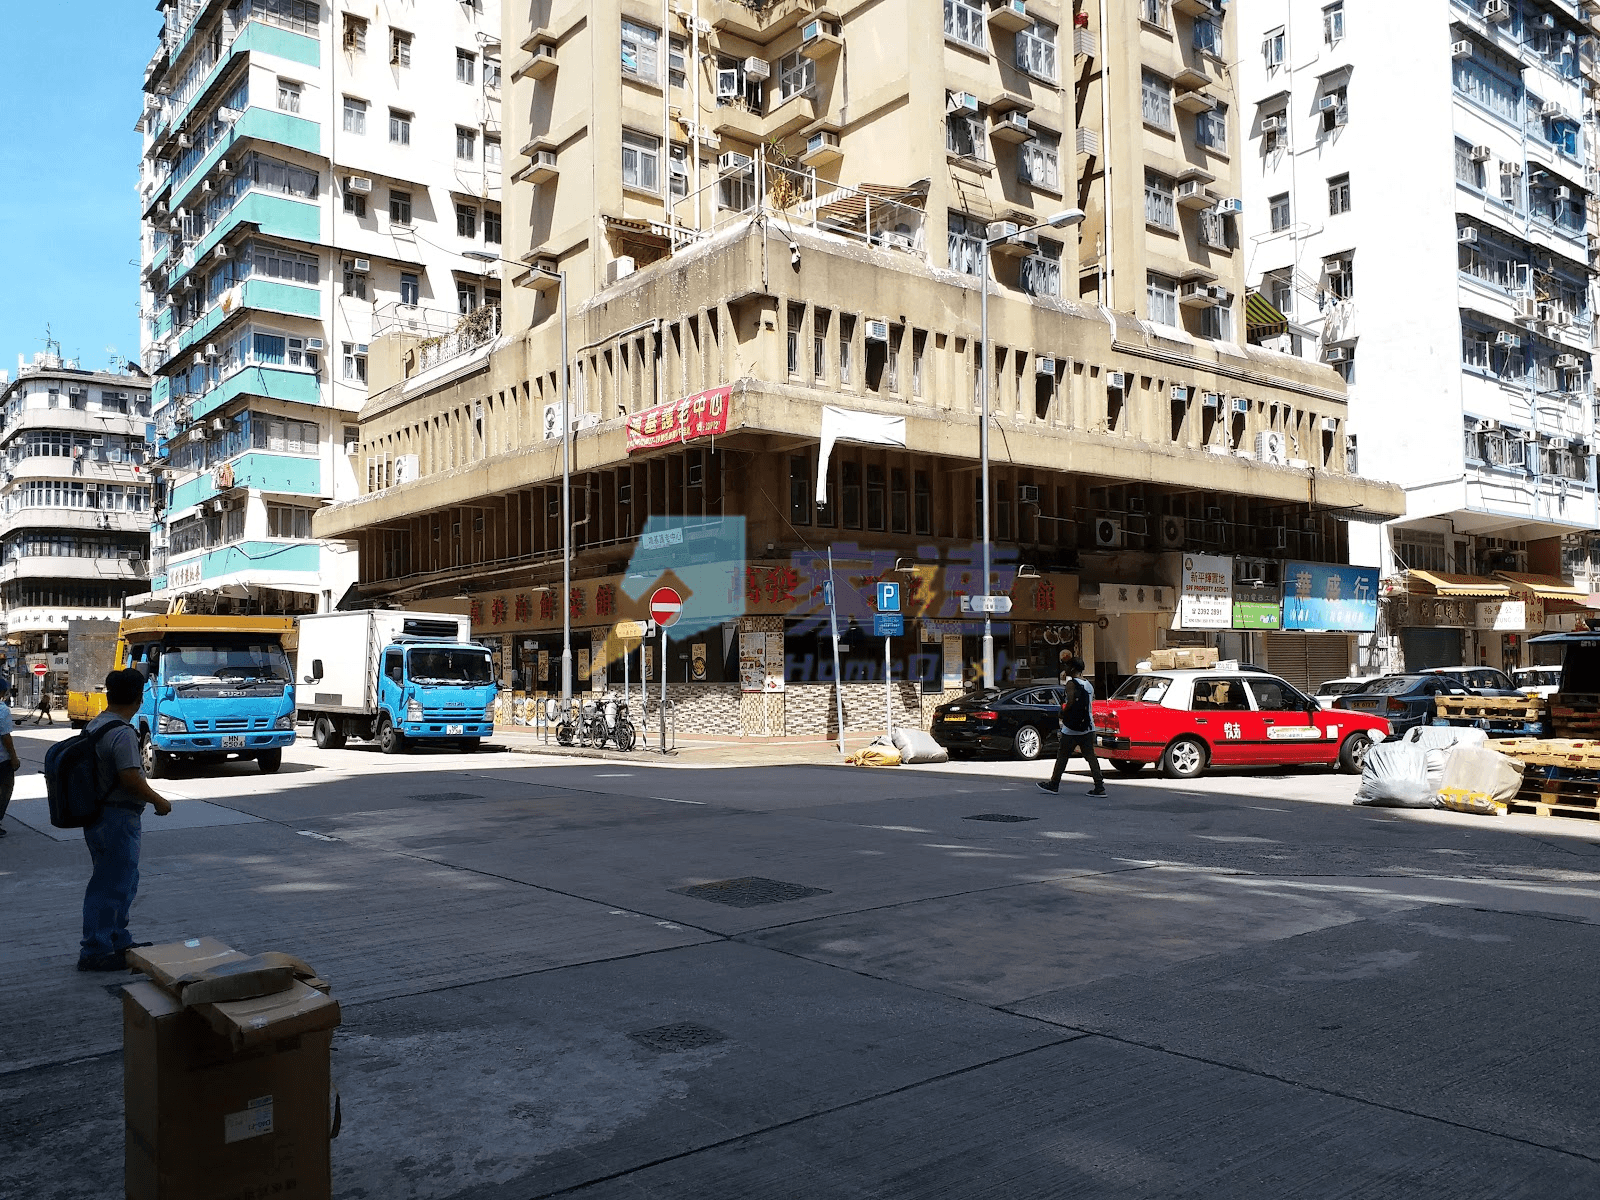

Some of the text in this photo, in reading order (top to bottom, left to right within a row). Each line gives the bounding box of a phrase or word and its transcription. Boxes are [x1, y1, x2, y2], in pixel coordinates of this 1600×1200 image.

[1194, 584, 1214, 592] PROPERTY
[1214, 585, 1229, 593] AGENCY
[884, 585, 894, 608] P
[1223, 721, 1241, 731] 的士
[1224, 730, 1241, 740] TAXI
